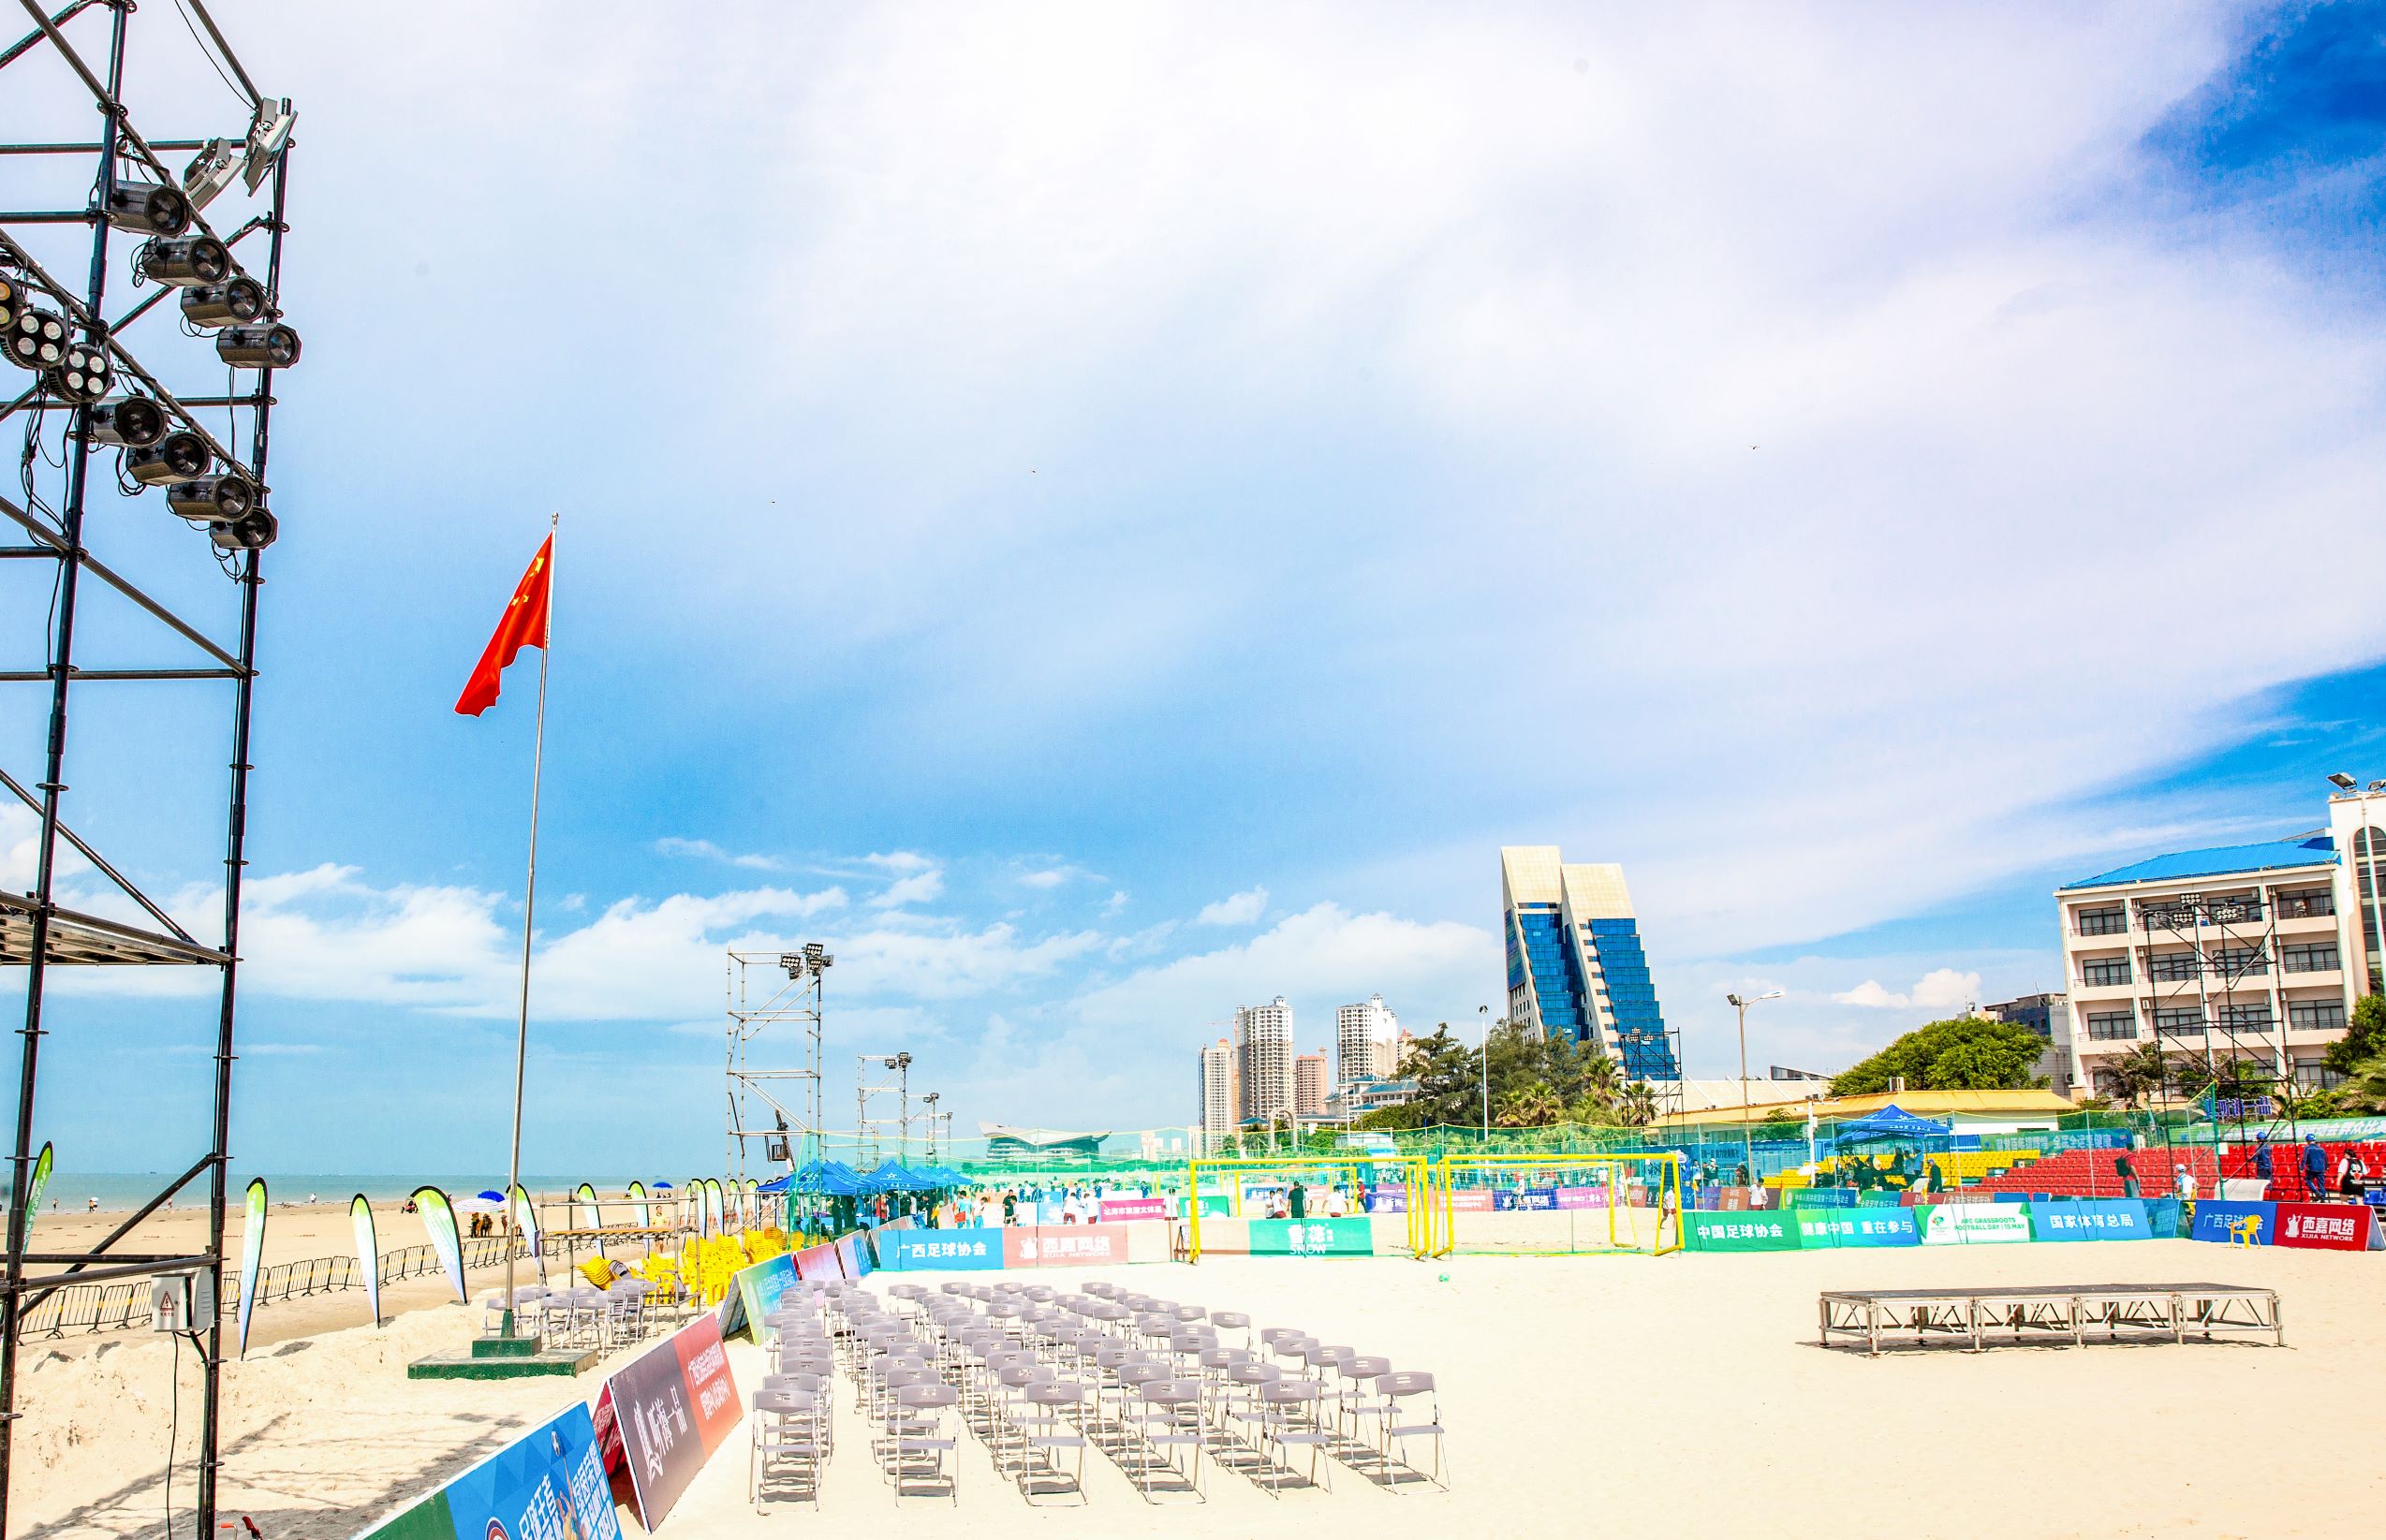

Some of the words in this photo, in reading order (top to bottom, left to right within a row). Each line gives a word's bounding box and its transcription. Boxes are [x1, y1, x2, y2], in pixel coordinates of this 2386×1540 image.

[1801, 1222, 1855, 1236] 健康中国
[1861, 1220, 1913, 1235] 重在参与
[2049, 1213, 2134, 1229] 国家体育总局
[2303, 1216, 2356, 1236] 西嘉网络
[1696, 1223, 1784, 1239] 中国足球协会
[2320, 1234, 2354, 1242] NETWORK
[896, 1241, 986, 1258] 广西足球协会
[1289, 1243, 1326, 1254] SNOW
